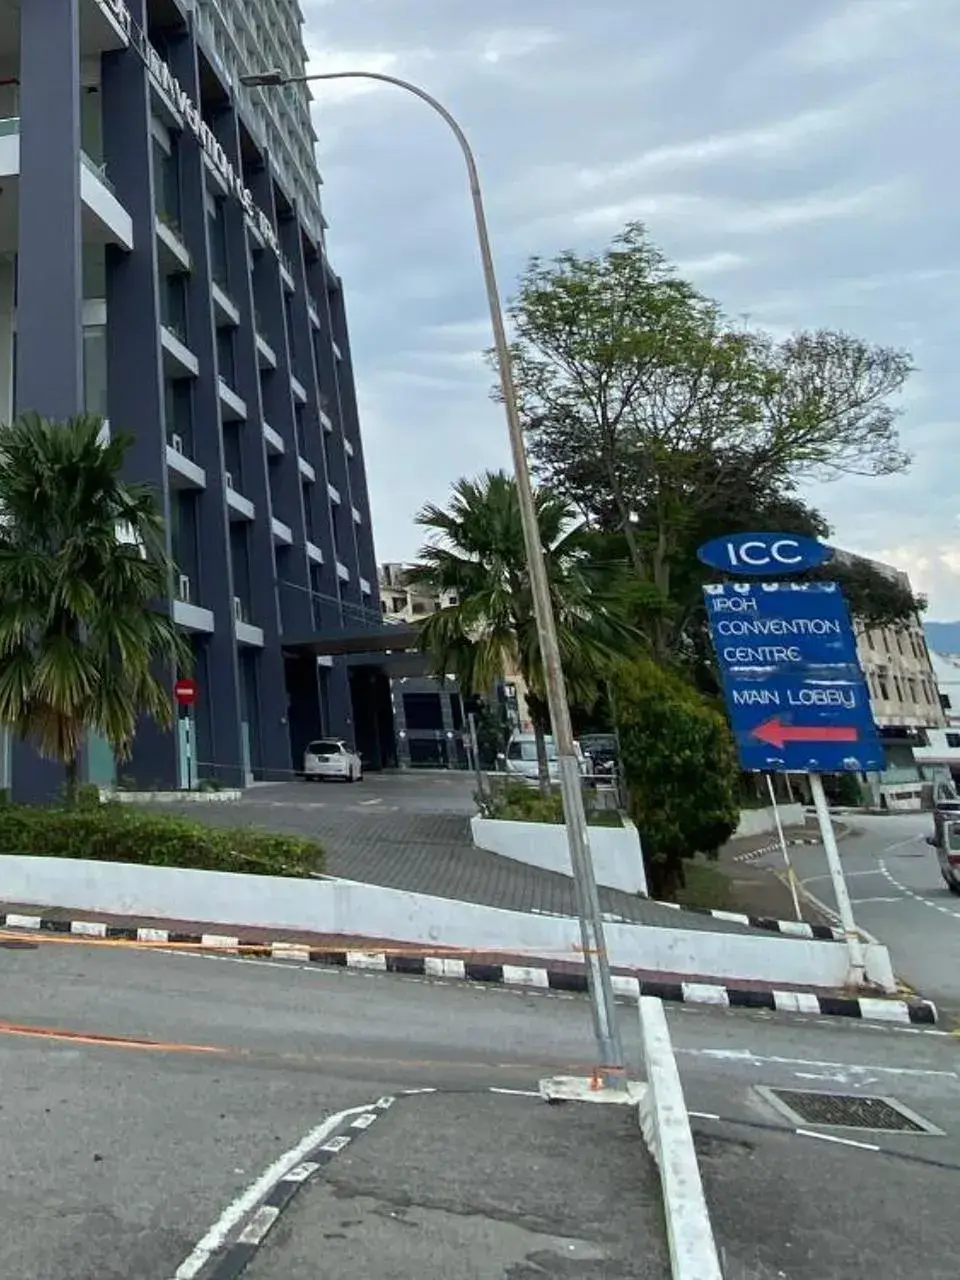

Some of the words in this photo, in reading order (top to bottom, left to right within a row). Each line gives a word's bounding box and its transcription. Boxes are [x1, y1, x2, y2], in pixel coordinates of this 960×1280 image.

[727, 540, 802, 566] ICC
[712, 597, 758, 613] IPOH
[717, 618, 841, 636] CONVENTION
[723, 645, 802, 663] CENTRE
[732, 689, 780, 706] MAIN
[787, 688, 856, 709] LOBBY
